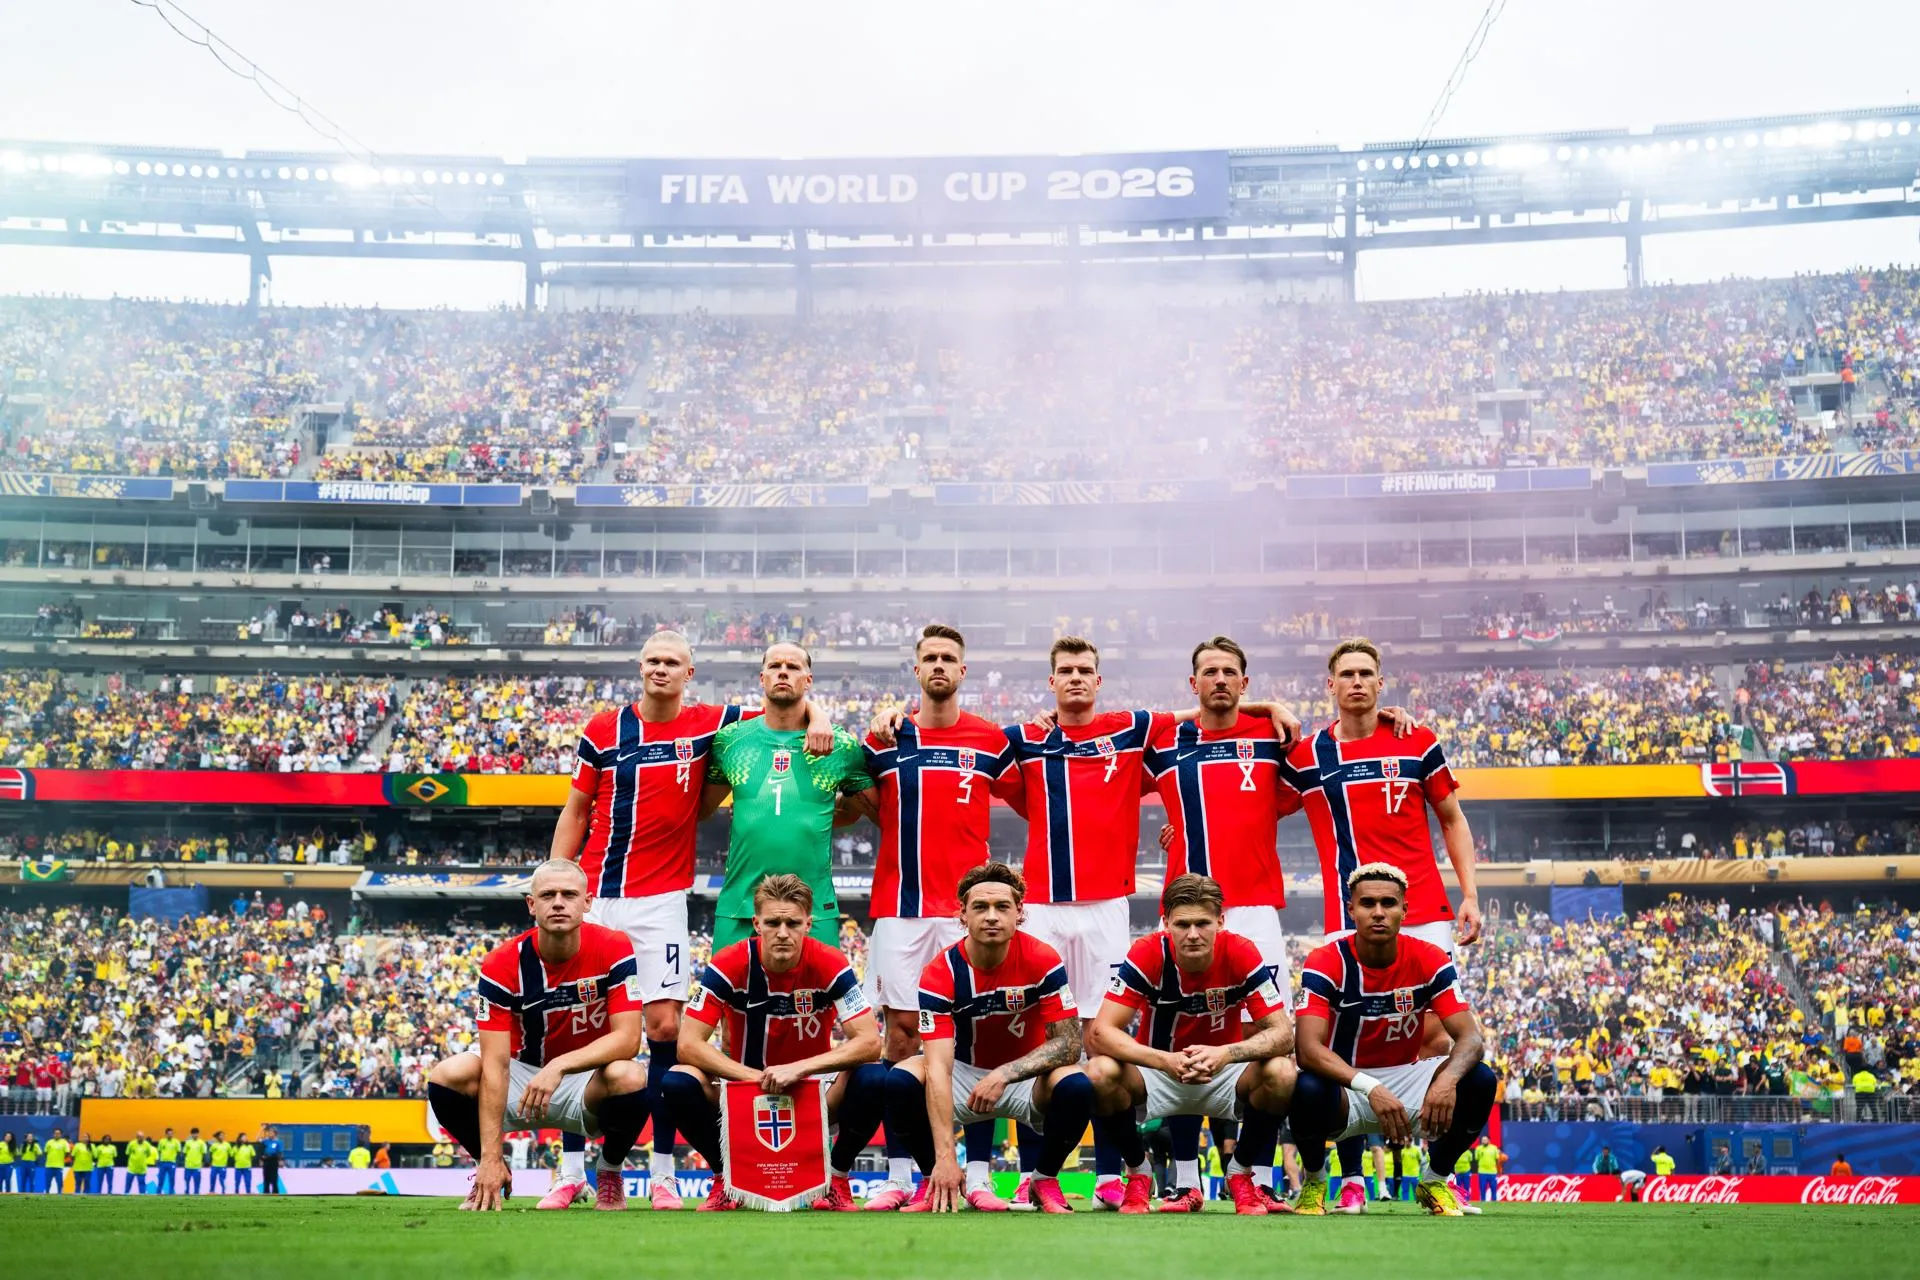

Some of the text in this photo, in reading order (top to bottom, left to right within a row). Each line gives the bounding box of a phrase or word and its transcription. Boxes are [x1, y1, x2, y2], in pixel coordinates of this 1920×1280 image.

[661, 166, 1195, 204] FIFA WORLD CUP 2026
[318, 483, 430, 504] #FIFAWorldCup
[1381, 473, 1496, 493] #FIFAWorldCup
[676, 762, 690, 793] 9
[1104, 754, 1118, 783] 7
[1238, 762, 1256, 791] 8
[771, 784, 781, 816] 1
[956, 772, 974, 804] 3
[1381, 782, 1409, 814] 17
[666, 944, 680, 975] 9
[572, 1001, 608, 1035] 26
[793, 1016, 821, 1041] 10
[1007, 1013, 1025, 1038] 6
[1210, 1012, 1226, 1033] 5
[1385, 1013, 1419, 1042] 20
[1642, 1175, 1744, 1203] Coca-Cola
[1801, 1176, 1902, 1204] Coca-Cola
